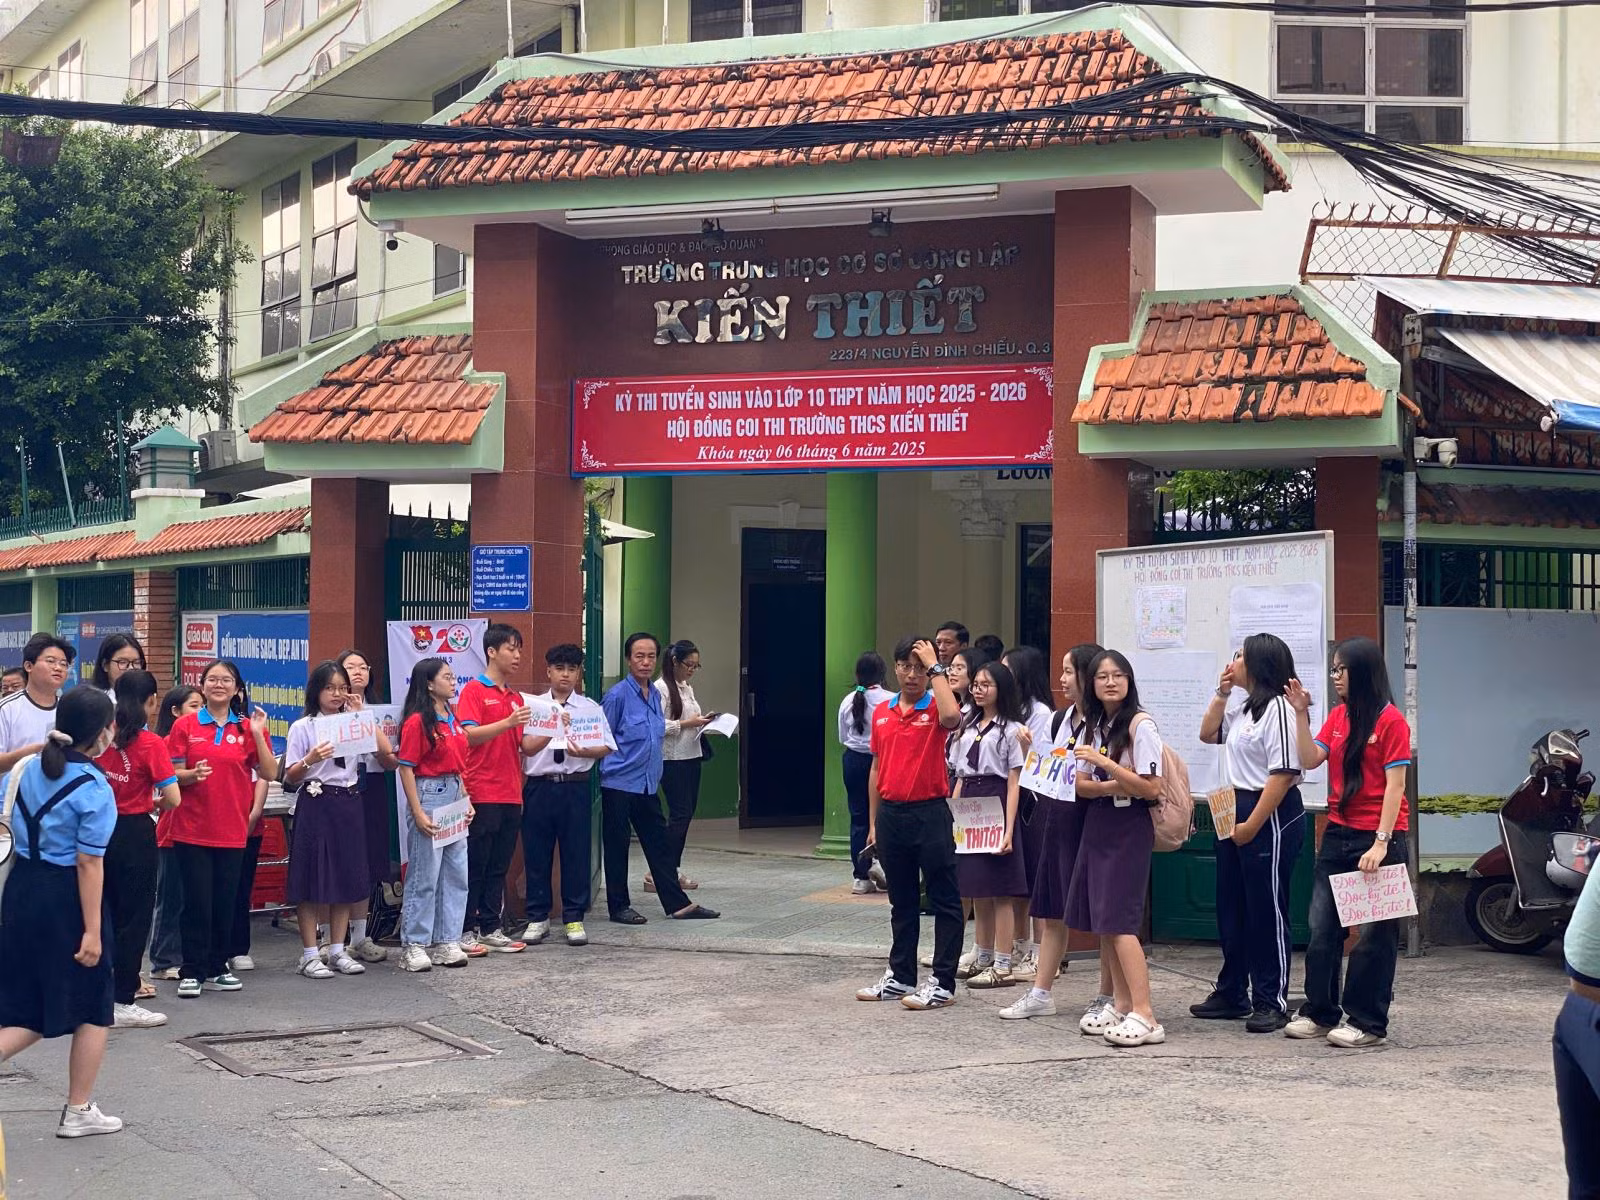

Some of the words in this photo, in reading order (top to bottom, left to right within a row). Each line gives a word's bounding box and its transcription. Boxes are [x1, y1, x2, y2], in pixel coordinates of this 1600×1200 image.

[679, 242, 686, 253] &
[621, 255, 705, 285] TRƯỜNG
[708, 259, 778, 281] TRUNG
[785, 256, 830, 283] HỌC
[837, 250, 867, 275] CƠ
[653, 282, 791, 345] KIẾN
[806, 273, 986, 339] THIẾT
[829, 348, 868, 361] 223/4
[872, 340, 930, 360] NGUYỄN
[934, 341, 968, 357] ĐÌNH
[615, 389, 633, 412] KỲ
[636, 392, 657, 411] THI
[661, 384, 704, 411] TUYỂN
[708, 390, 742, 410] SINH
[744, 386, 773, 409] VÀO
[776, 386, 804, 408] LỚP
[807, 388, 825, 408] 10
[828, 386, 864, 406] THPT
[867, 382, 902, 406] NĂM
[905, 384, 936, 408] HỌC
[939, 383, 976, 404] 2025
[990, 382, 1027, 402] 2026
[667, 416, 690, 442] HỘI
[693, 413, 732, 438] ĐỒNG
[736, 418, 759, 438] COI
[763, 417, 785, 437] THI
[789, 411, 846, 437] TRƯỜNG
[849, 414, 886, 435] THCS
[890, 408, 925, 434] KIẾN
[928, 407, 969, 433] THIẾT
[696, 444, 734, 460] Khóa
[738, 445, 772, 463] ngày
[775, 444, 793, 459] 06
[796, 443, 838, 461] tháng
[841, 443, 850, 457] 6
[854, 442, 886, 457] năm
[890, 441, 926, 457] 2025
[237, 633, 260, 659] TRƯỜNG
[339, 719, 374, 743] LÊN
[983, 824, 1003, 849] TỐT
